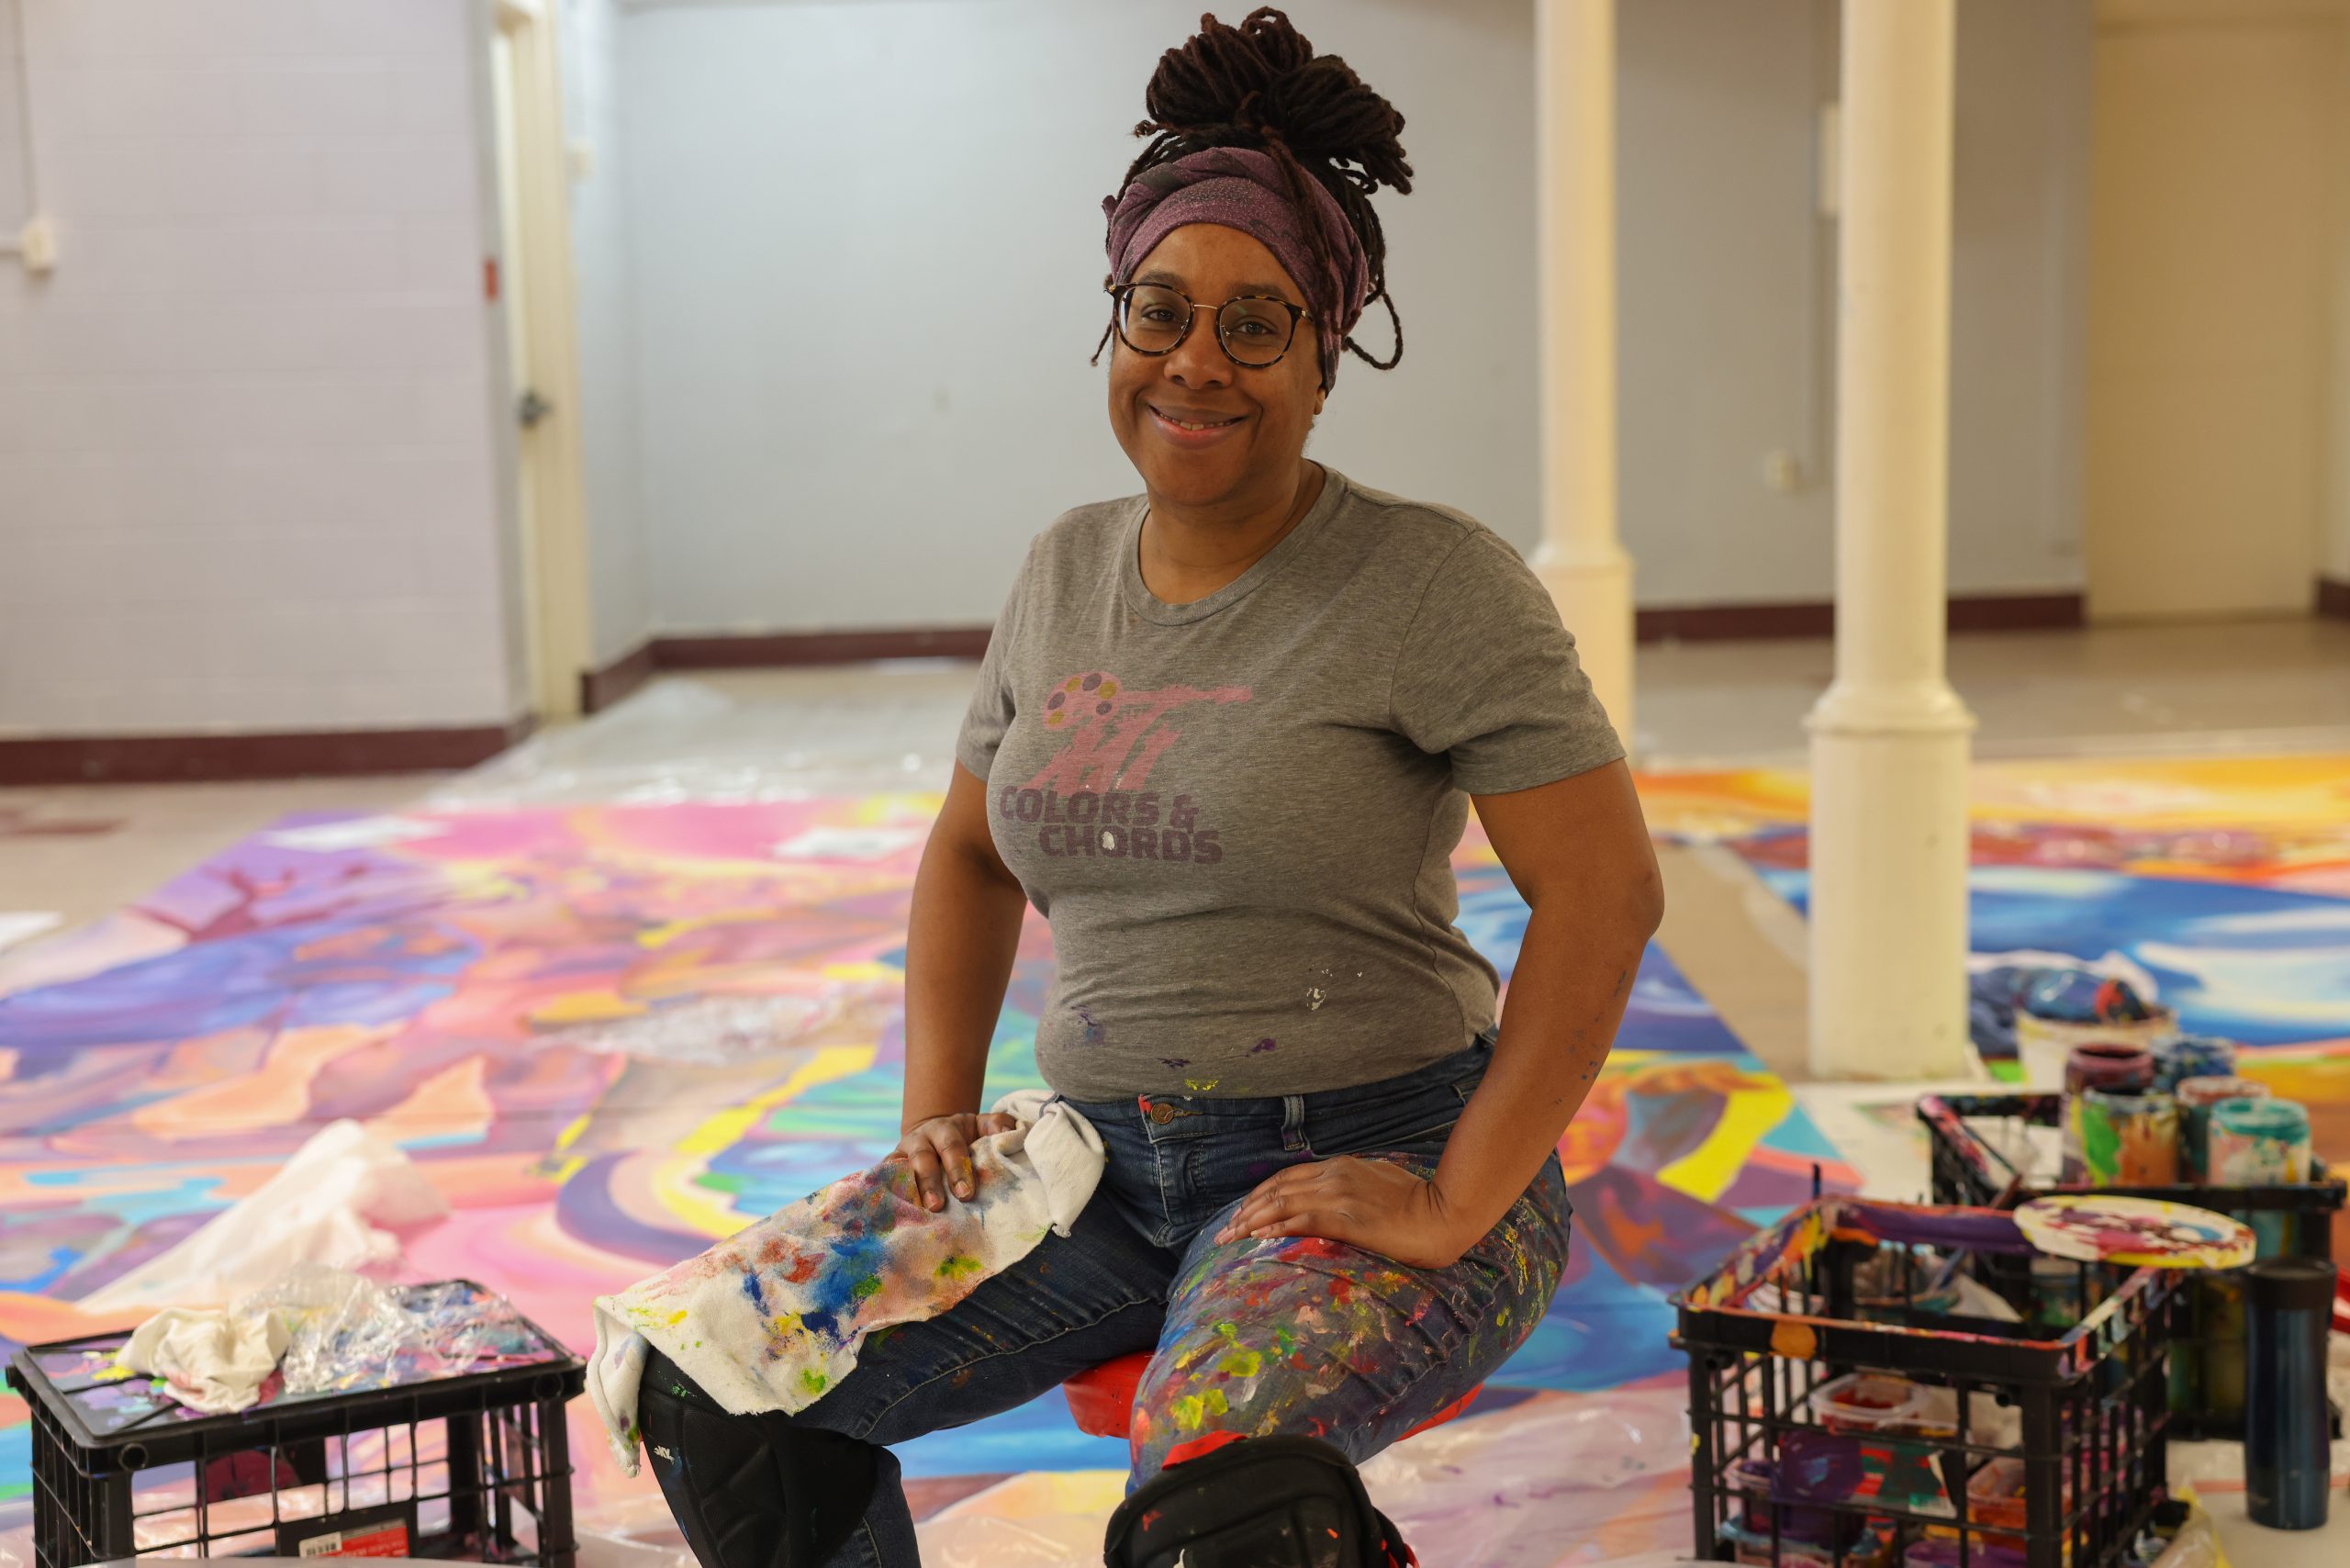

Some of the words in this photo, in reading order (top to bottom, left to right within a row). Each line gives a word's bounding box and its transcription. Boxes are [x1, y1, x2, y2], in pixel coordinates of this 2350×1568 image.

[1000, 785, 1160, 825] COLORS
[1169, 794, 1200, 834] &
[1039, 826, 1223, 864] CHORDS
